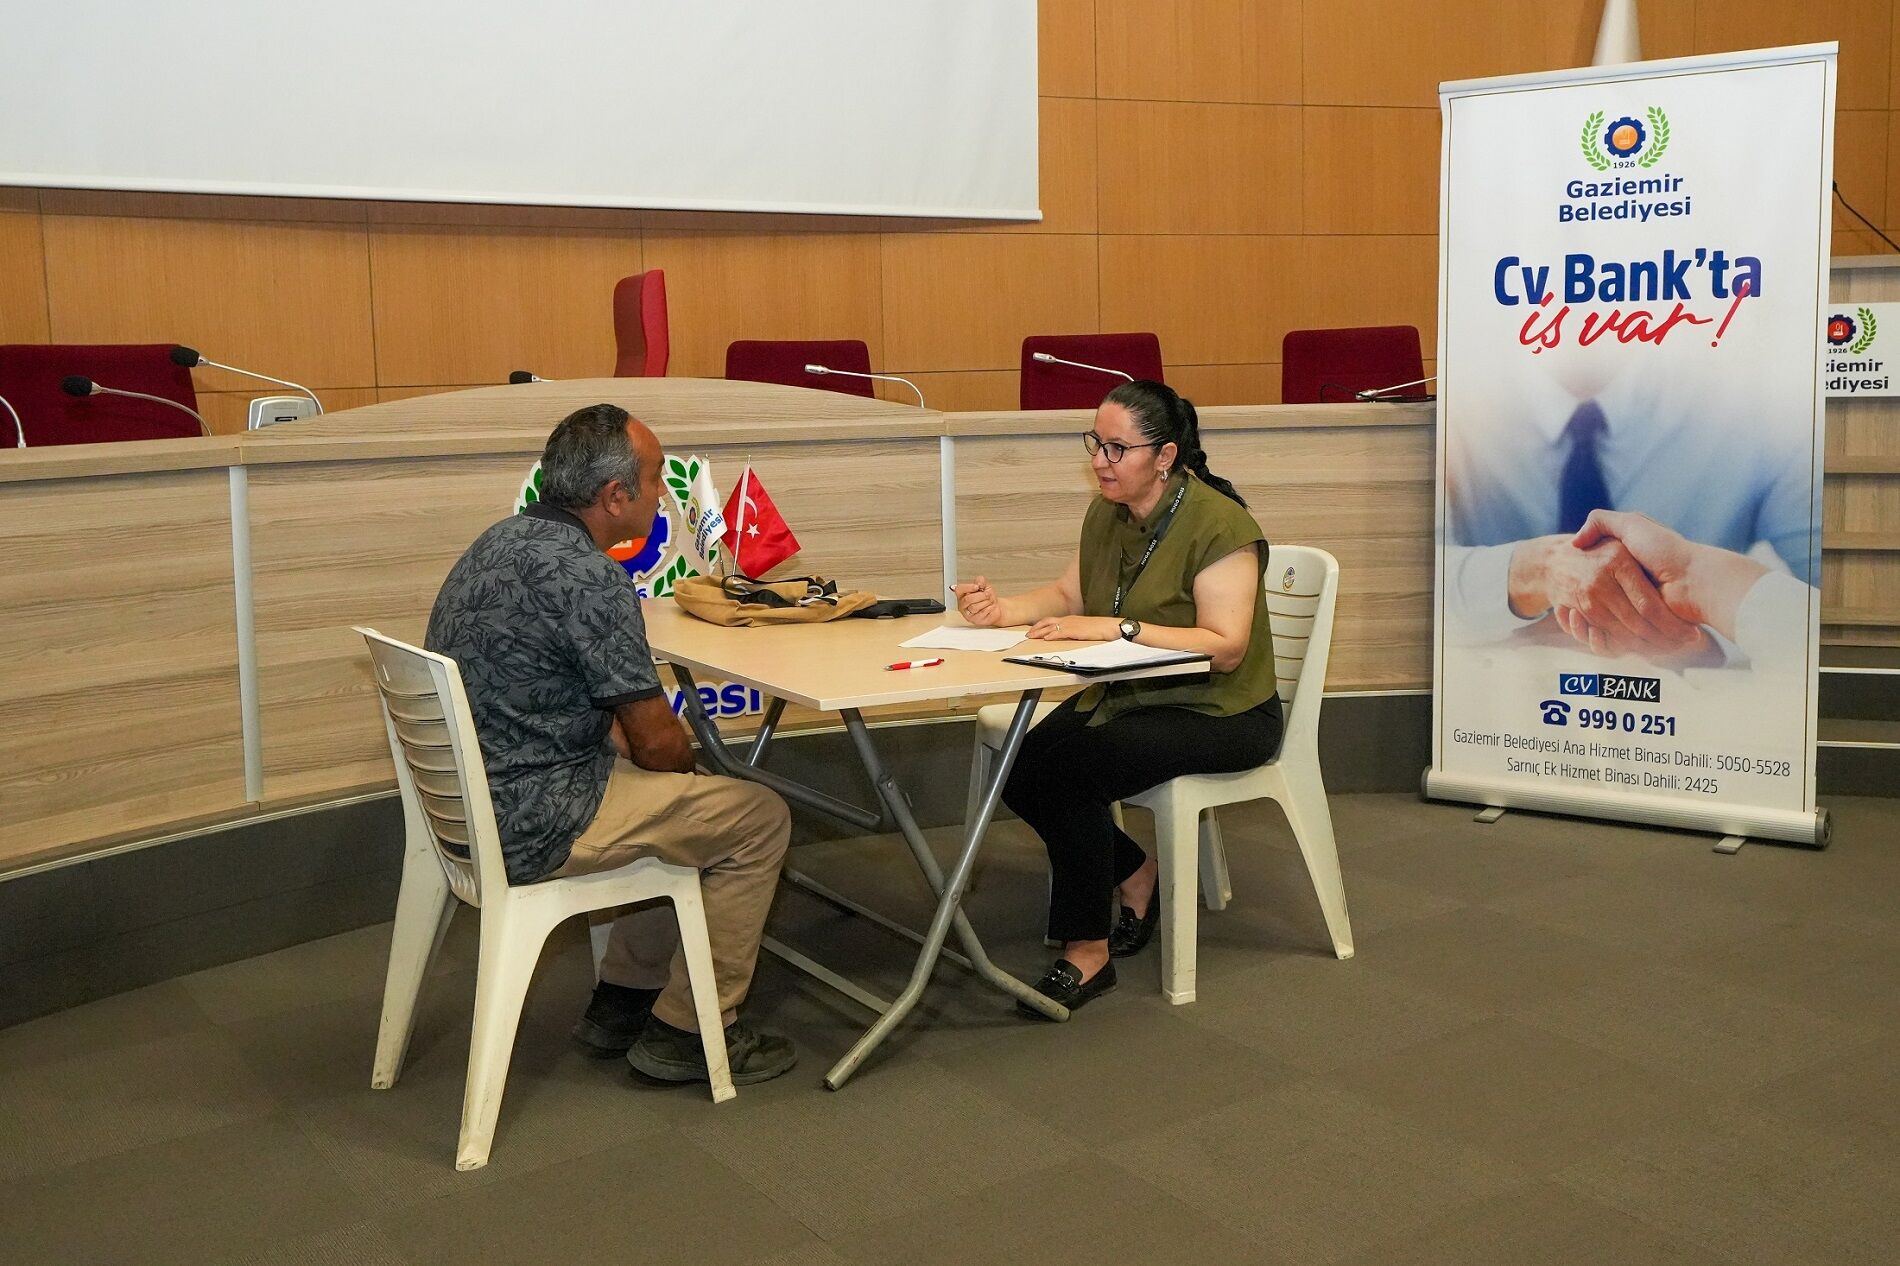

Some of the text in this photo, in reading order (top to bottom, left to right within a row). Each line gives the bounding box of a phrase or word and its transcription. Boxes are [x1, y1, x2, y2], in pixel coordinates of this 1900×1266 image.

[1613, 160, 1635, 169] 1926
[1566, 173, 1684, 198] Gaziemir
[1559, 196, 1691, 222] Belediyesi
[1494, 247, 1761, 305] Cv Bank'ta
[1519, 292, 1569, 354] iş
[1826, 359, 1884, 372] iemir
[1564, 676, 1658, 699] CV BANK
[1578, 708, 1676, 737] 999 0 251
[1453, 728, 1791, 777] Gaziemir Belediyesi Ana Hizmet Binası Dahili: 5050-5528
[1507, 757, 1718, 794] Sarnıç Ek Hizmet Binası Dahili: 2425
